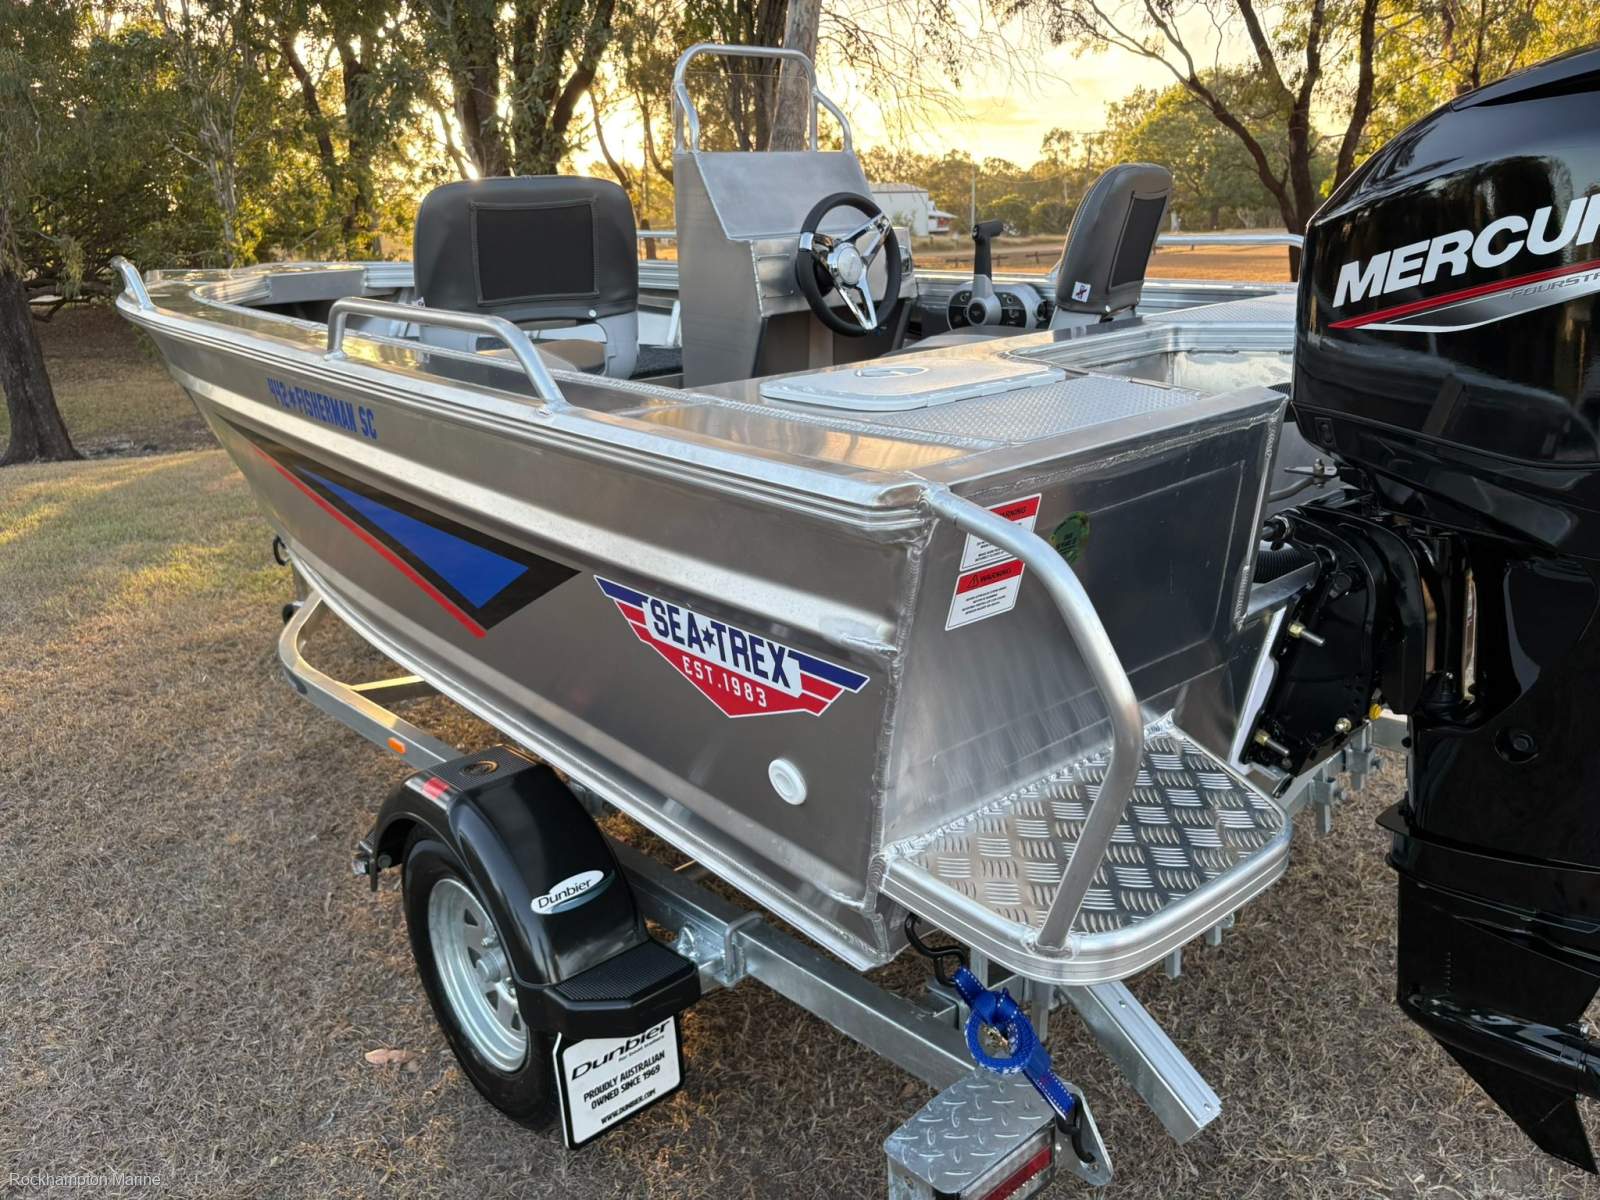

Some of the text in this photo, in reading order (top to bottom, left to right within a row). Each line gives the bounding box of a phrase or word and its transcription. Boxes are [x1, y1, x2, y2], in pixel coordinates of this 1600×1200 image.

[359, 405, 378, 439] SC
[538, 879, 592, 908] Dunbier
[571, 1020, 670, 1081] Dunbier
[583, 1049, 665, 1103] PROUDLY AUSTRALIAN
[591, 1064, 660, 1109] OWNED SINCE 1969
[600, 1088, 656, 1125] WWW.DUNBIER.COM
